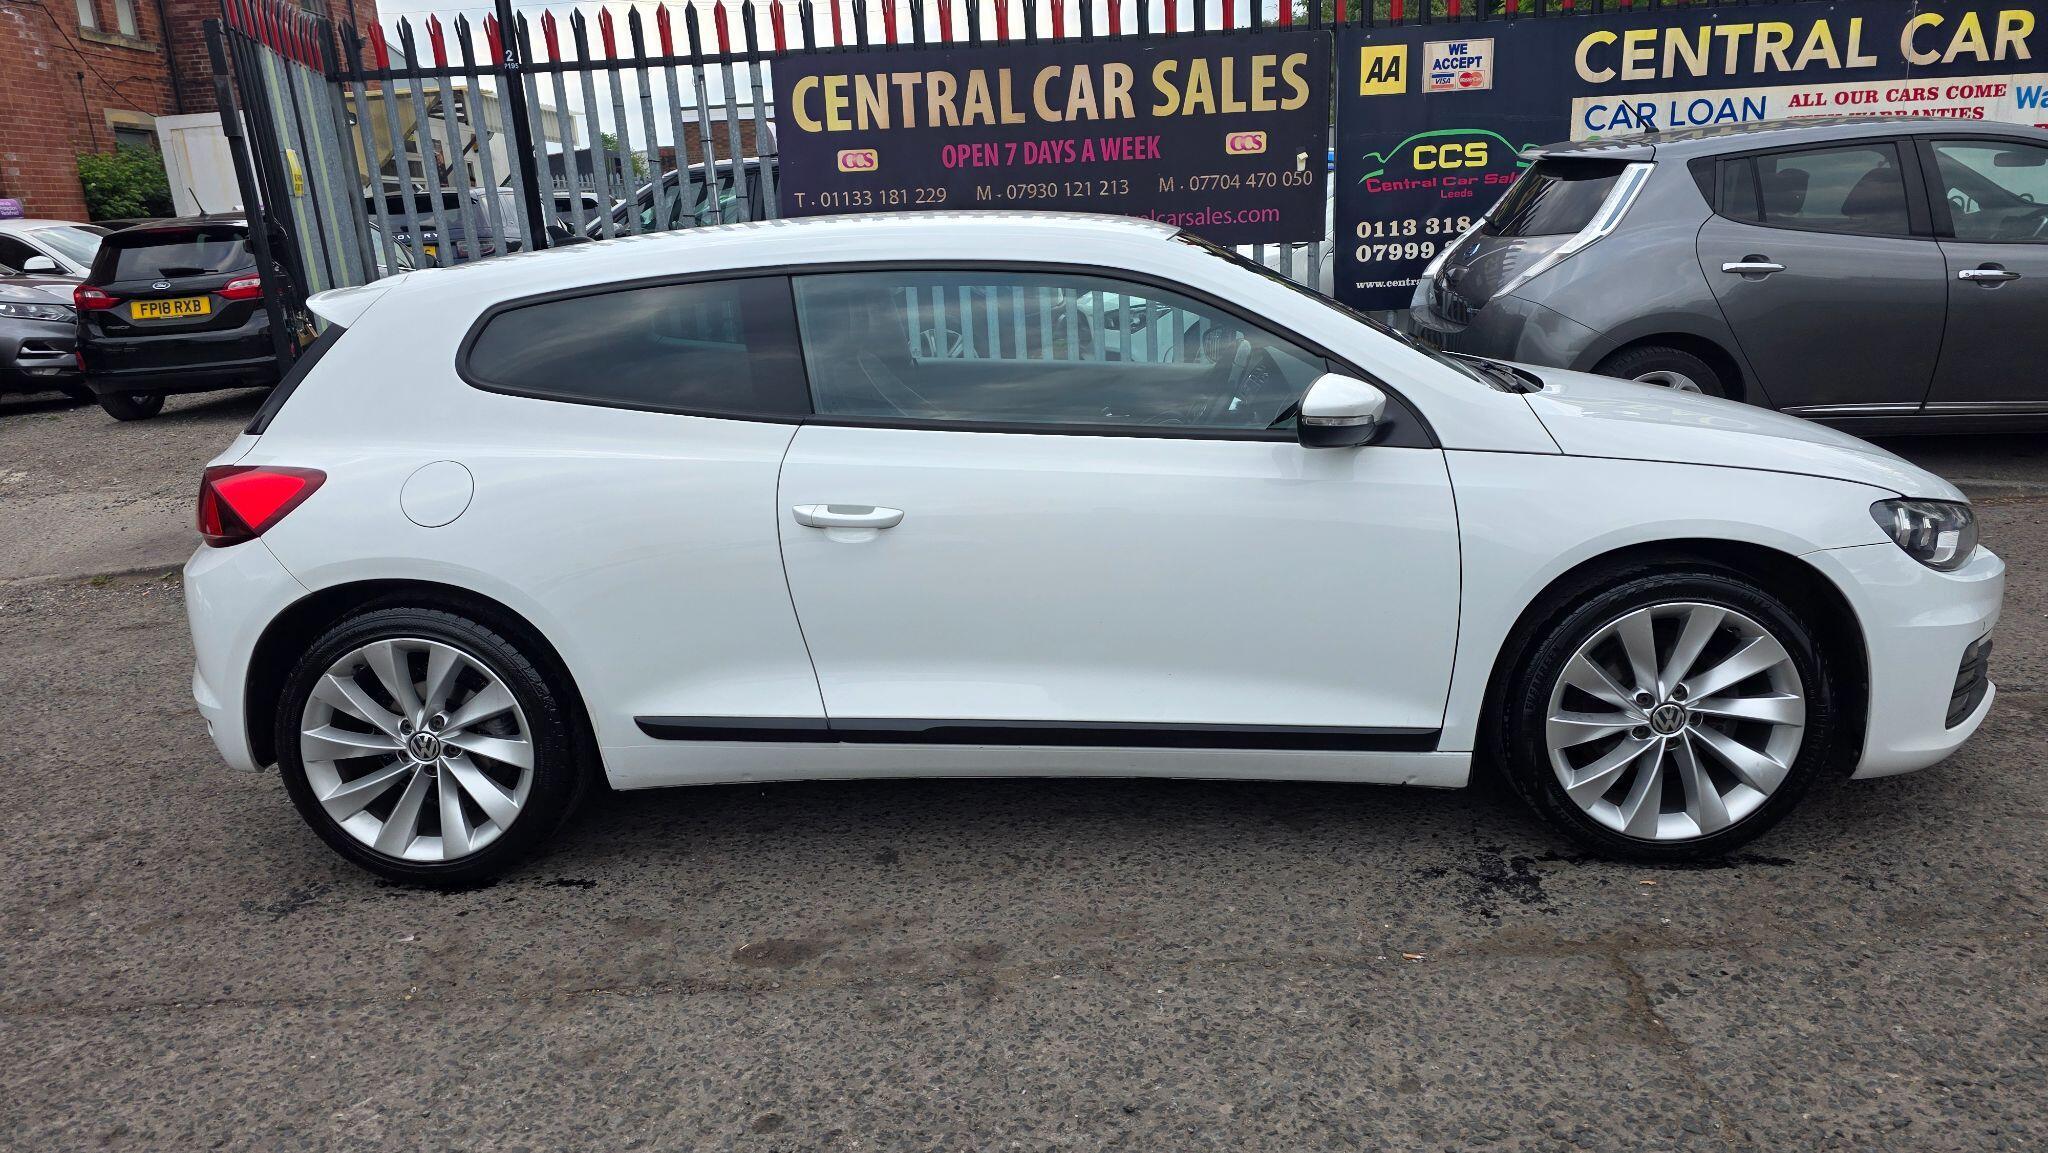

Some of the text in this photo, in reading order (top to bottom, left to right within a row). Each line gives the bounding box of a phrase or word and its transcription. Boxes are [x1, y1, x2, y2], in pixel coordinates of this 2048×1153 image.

[505, 49, 514, 61] 2
[1448, 43, 1468, 55] WE
[1574, 9, 2035, 84] CENTRAL CAR
[1365, 55, 1401, 83] AA
[1433, 55, 1482, 70] ACCEPT
[1435, 77, 1451, 85] VISA
[792, 53, 1310, 132] CENTRAL CAR SALES
[1788, 84, 2007, 107] ALL OUR CARS COME
[1584, 95, 1767, 131] CAR LOAN
[942, 135, 1161, 168] OPEN 7 DAYS A WEEK
[1230, 134, 1263, 151] CCS
[842, 153, 875, 168] CCS
[1413, 142, 1488, 170] CCS
[1006, 183, 1058, 200] 07930
[1064, 181, 1092, 197] 121
[1099, 179, 1129, 196] 213
[1189, 174, 1240, 191] 07704
[1246, 171, 1277, 188] 470
[1282, 170, 1313, 187] 050
[1366, 177, 1436, 193] Central
[1442, 176, 1479, 187] Car
[820, 191, 873, 207] 01133
[879, 189, 908, 205] 181
[915, 187, 947, 204] 229
[1440, 188, 1473, 199] Leeds
[1356, 216, 1471, 238] 0113 318
[1355, 241, 1435, 263] 07999
[140, 299, 202, 316] FP18 RXB
